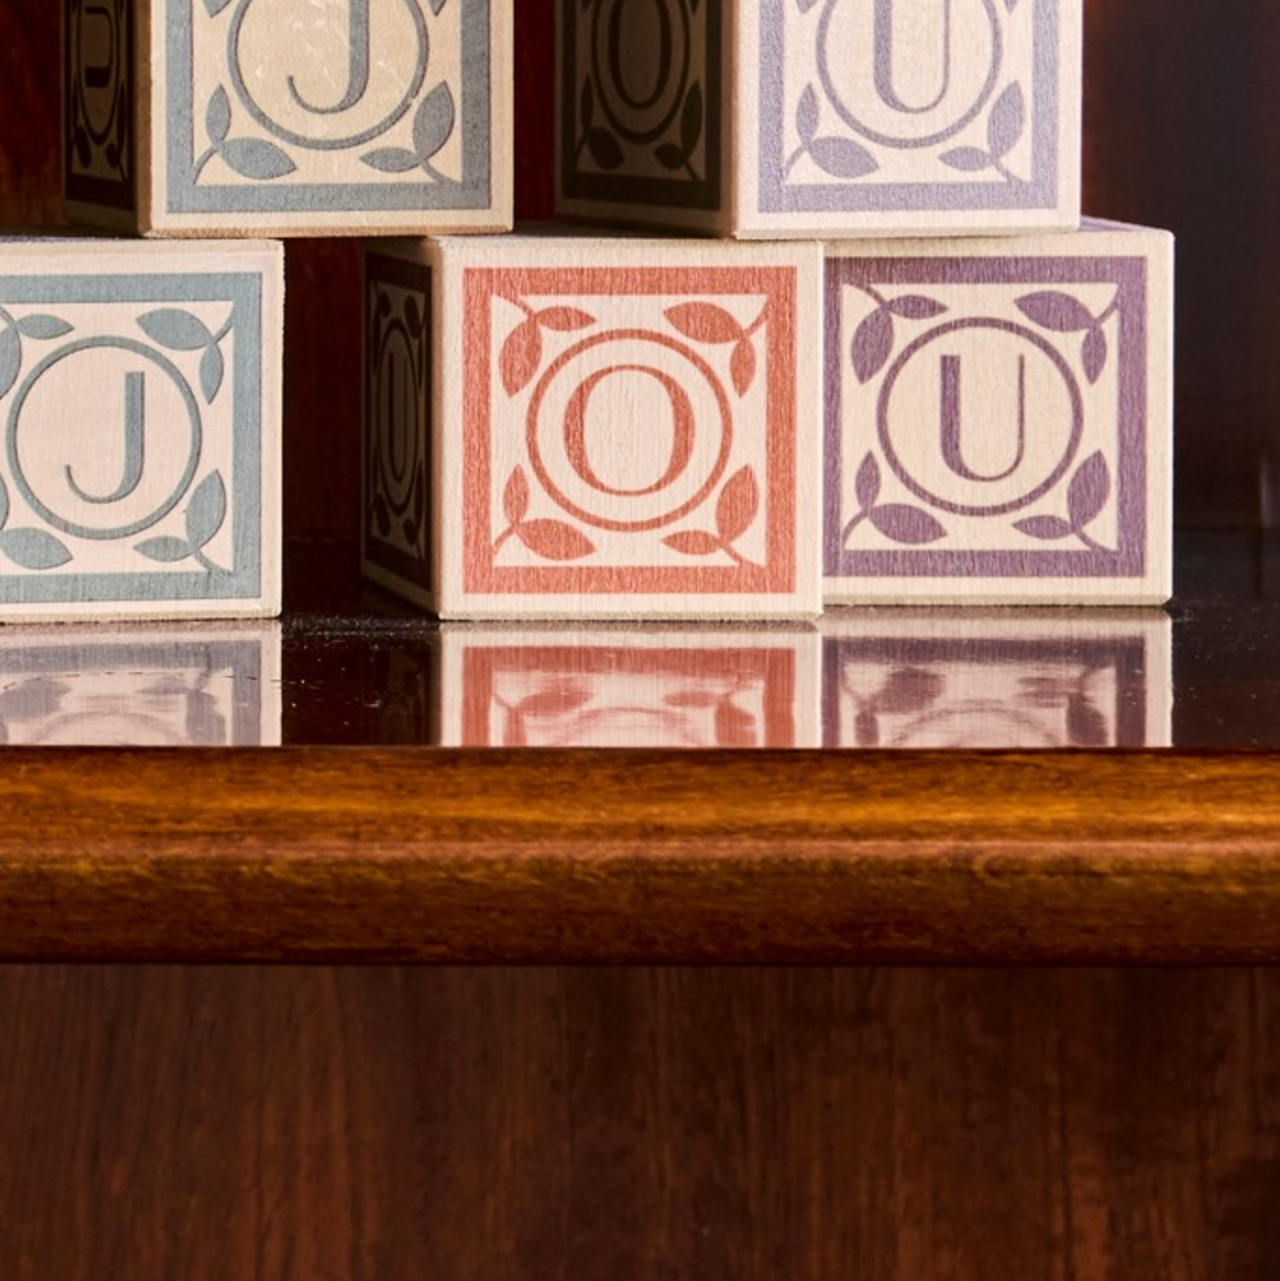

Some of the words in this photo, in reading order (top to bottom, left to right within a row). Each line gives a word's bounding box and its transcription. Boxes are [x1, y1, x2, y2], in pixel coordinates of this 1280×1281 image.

[63, 370, 146, 504] J
[389, 352, 408, 482] U
[563, 363, 695, 496] O
[940, 354, 1026, 483] U
